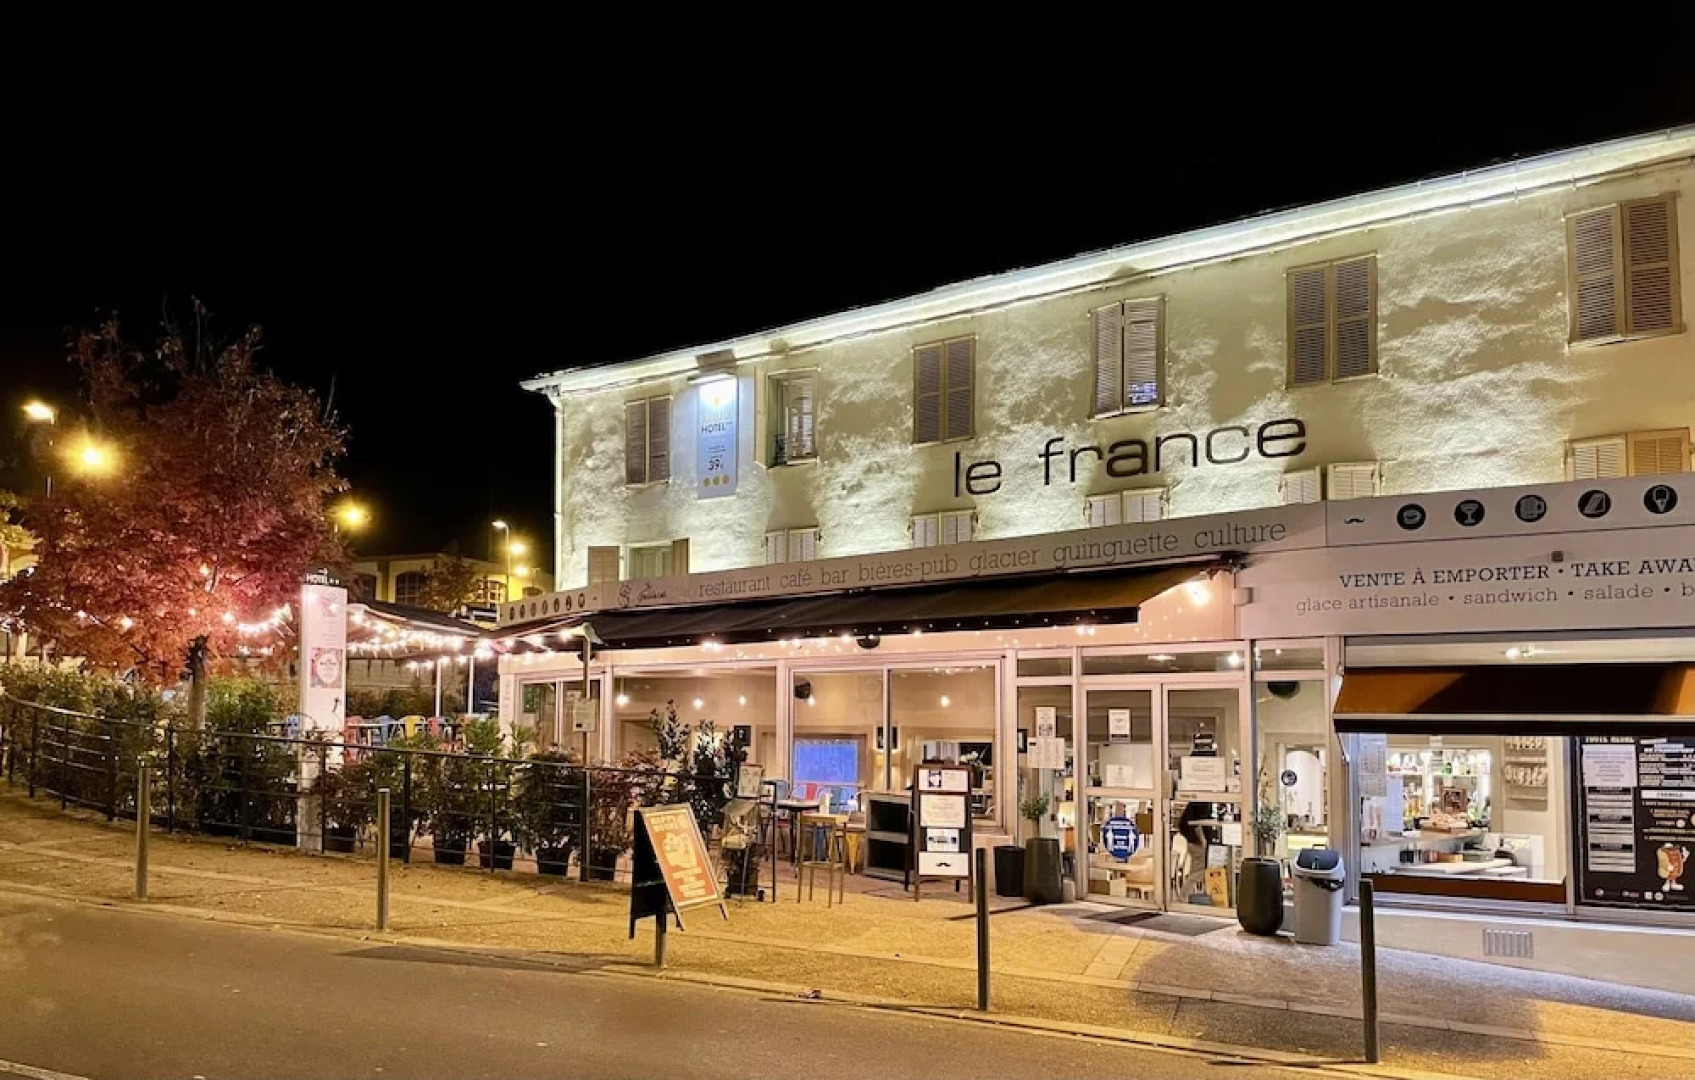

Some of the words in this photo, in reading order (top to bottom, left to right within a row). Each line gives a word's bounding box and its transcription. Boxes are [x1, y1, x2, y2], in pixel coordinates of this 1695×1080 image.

[954, 452, 1003, 497] le
[1038, 418, 1306, 485] france
[698, 578, 771, 598] restaurant
[779, 571, 813, 589] café
[821, 567, 850, 585] bar
[858, 554, 959, 582] bières-pub
[969, 548, 1040, 576] glacier
[1053, 531, 1179, 564] guinguette
[1194, 522, 1286, 549] culture
[1339, 571, 1405, 588] VENTE
[1411, 567, 1426, 584] À
[1433, 564, 1549, 584] EMPORTER
[1571, 559, 1630, 578] TAKE
[1638, 557, 1695, 574] AWA
[1296, 596, 1342, 616] glace
[1349, 591, 1440, 610] artisanale
[1463, 586, 1558, 605] sandwich
[1584, 583, 1654, 601] salade
